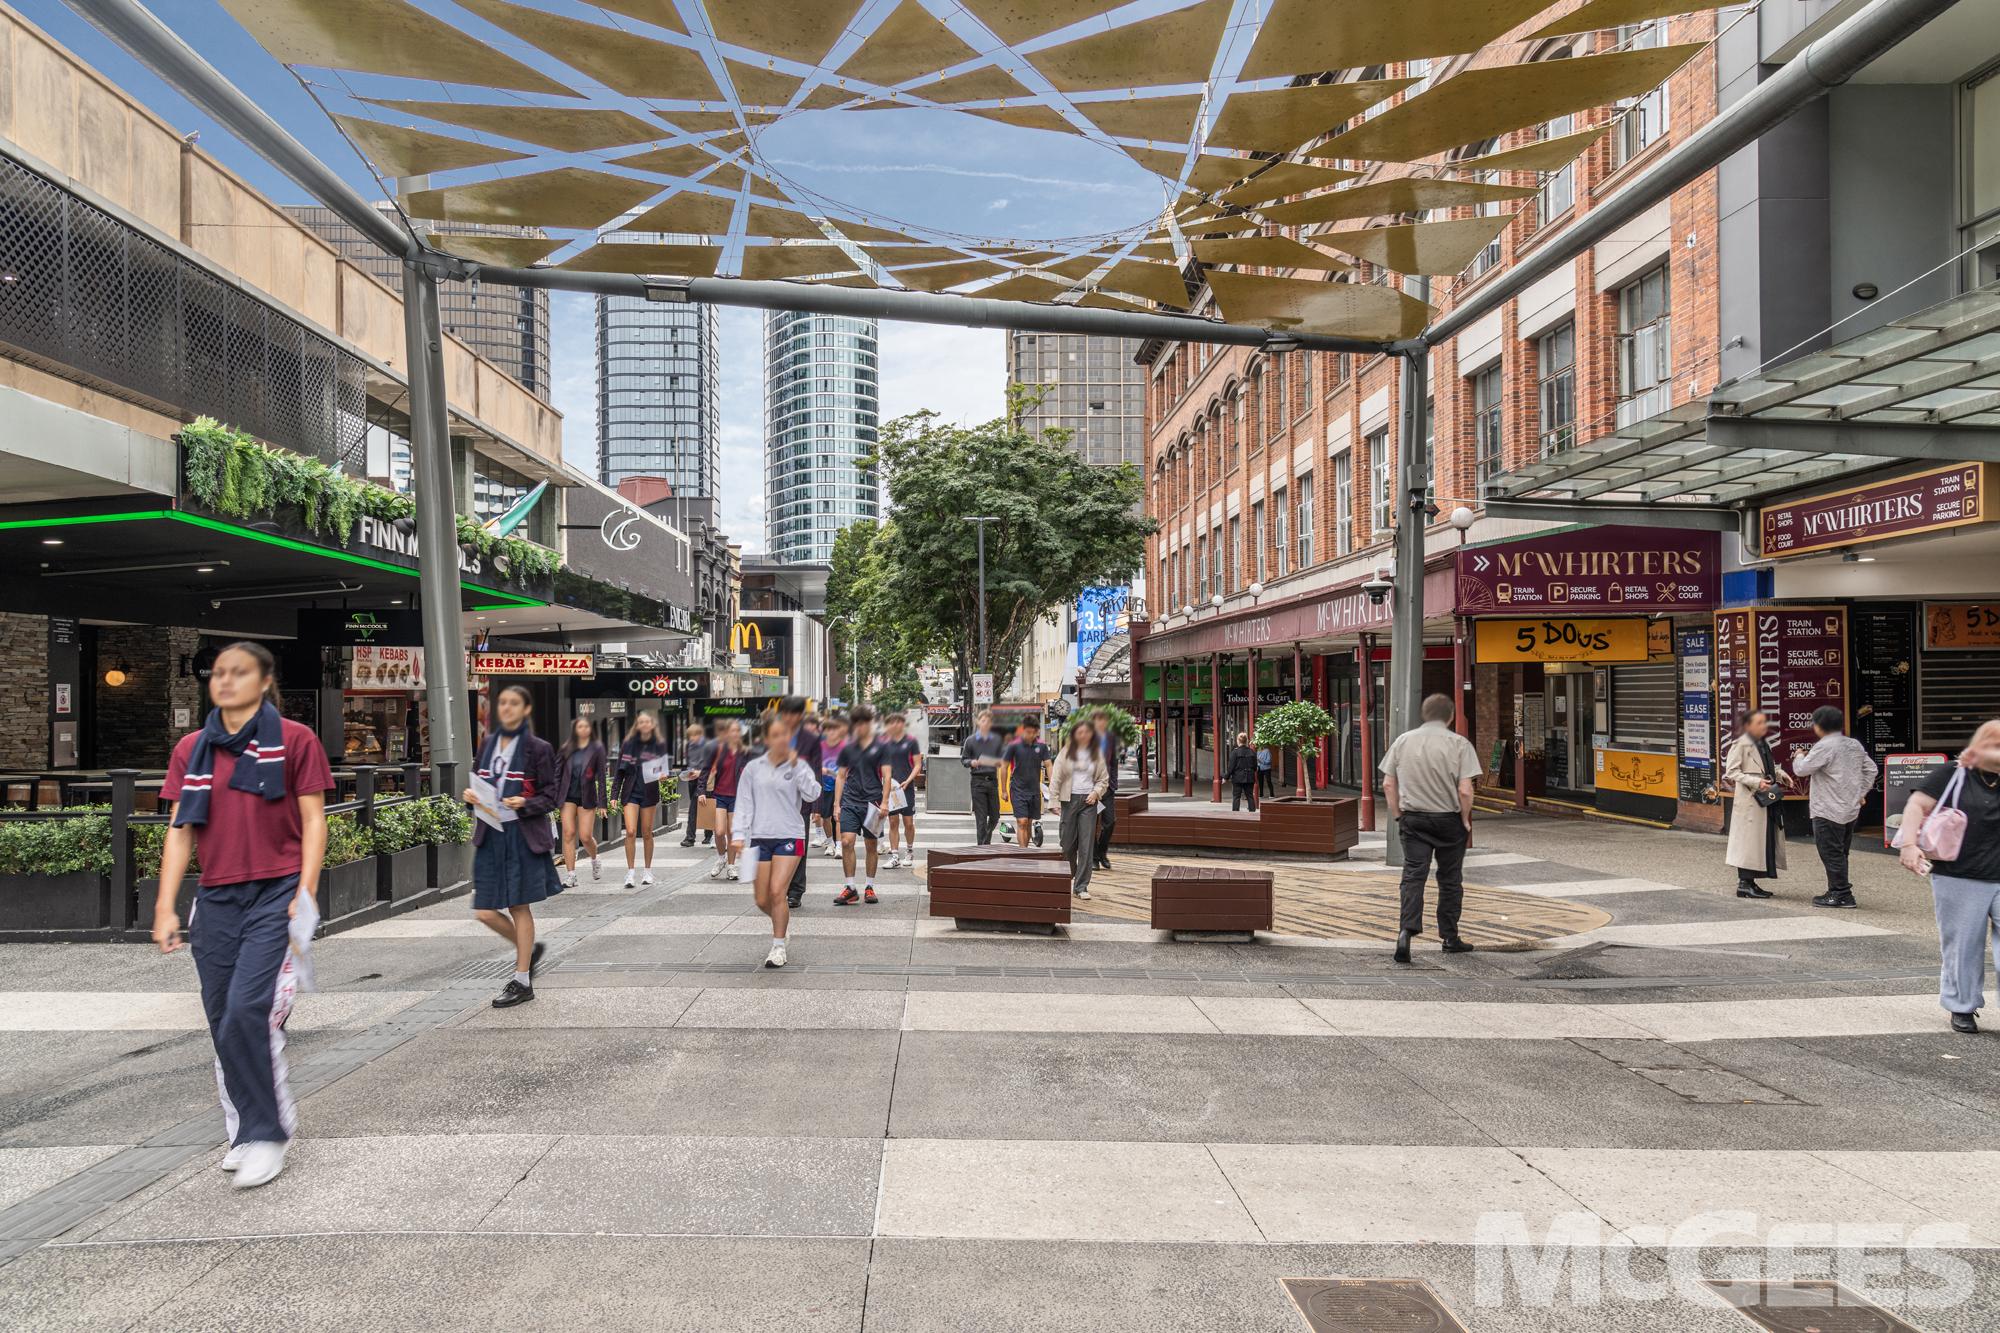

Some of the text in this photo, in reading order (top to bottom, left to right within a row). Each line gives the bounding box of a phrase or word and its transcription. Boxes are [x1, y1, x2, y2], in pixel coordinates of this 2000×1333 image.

[1940, 475, 1960, 485] TRAIN
[1933, 484, 1960, 496] STATION
[1936, 501, 1961, 511] SECURE
[1777, 512, 1793, 520] RETAIL
[1803, 493, 1923, 536] McWHIRTERS
[1932, 510, 1960, 520] PARKING
[1777, 519, 1793, 527] SHOPS
[358, 515, 404, 553] FINN
[1777, 540, 1794, 548] COURT
[1496, 550, 1702, 577] McWHIRTERS
[1967, 608, 1981, 628] 5
[1787, 628, 1822, 636] STATION
[1515, 626, 1536, 652] 5
[1686, 637, 1705, 648] SALE
[356, 646, 409, 661] HSP KEBABS
[1787, 650, 1819, 658] SECURE
[474, 658, 525, 668] KEBAB
[543, 659, 589, 669] PIZZA
[1787, 658, 1824, 666] PARKING
[628, 677, 699, 695] oporto
[1788, 682, 1815, 690] RETAIL
[1266, 693, 1291, 704] Cigars
[1788, 690, 1816, 698] SHOPS
[1685, 704, 1707, 713] LEASE
[1789, 713, 1813, 721] FOOD
